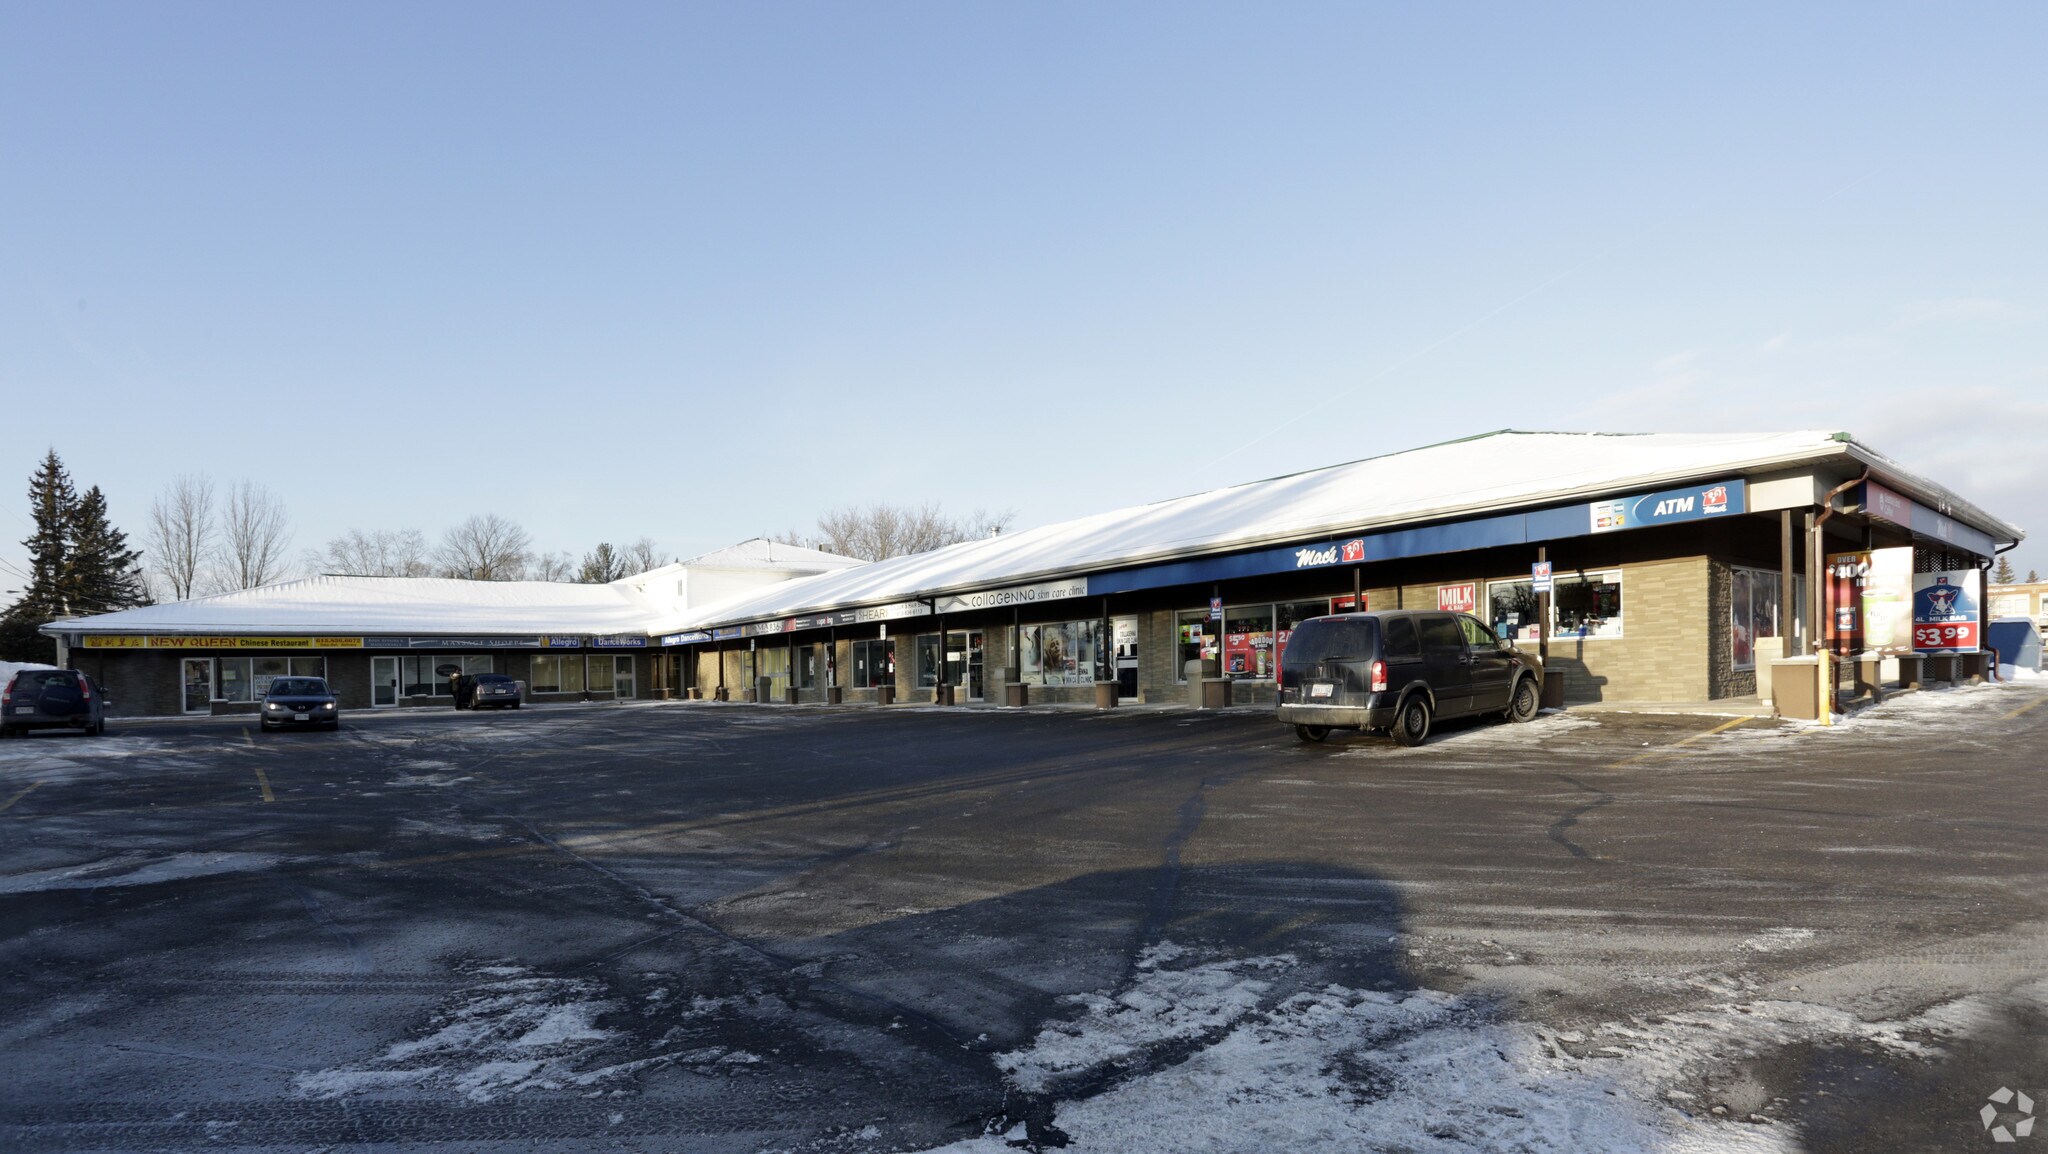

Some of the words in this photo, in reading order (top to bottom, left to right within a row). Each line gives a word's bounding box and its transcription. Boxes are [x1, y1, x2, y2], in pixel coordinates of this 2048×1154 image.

[1653, 496, 1695, 516] ATM
[1295, 546, 1339, 568] Mac's
[1837, 555, 1856, 563] OVER
[1052, 589, 1065, 597] care
[1068, 585, 1085, 596] clinic
[1441, 586, 1472, 606] MILK
[150, 637, 185, 647] NEW
[190, 637, 237, 647] QUEEN
[240, 639, 269, 647] Chinese
[271, 638, 309, 647] Restaurant
[441, 639, 485, 647] MASSAGE
[551, 638, 578, 648] Allegro
[598, 638, 641, 647] DanceWorks
[664, 635, 680, 645] Allegro
